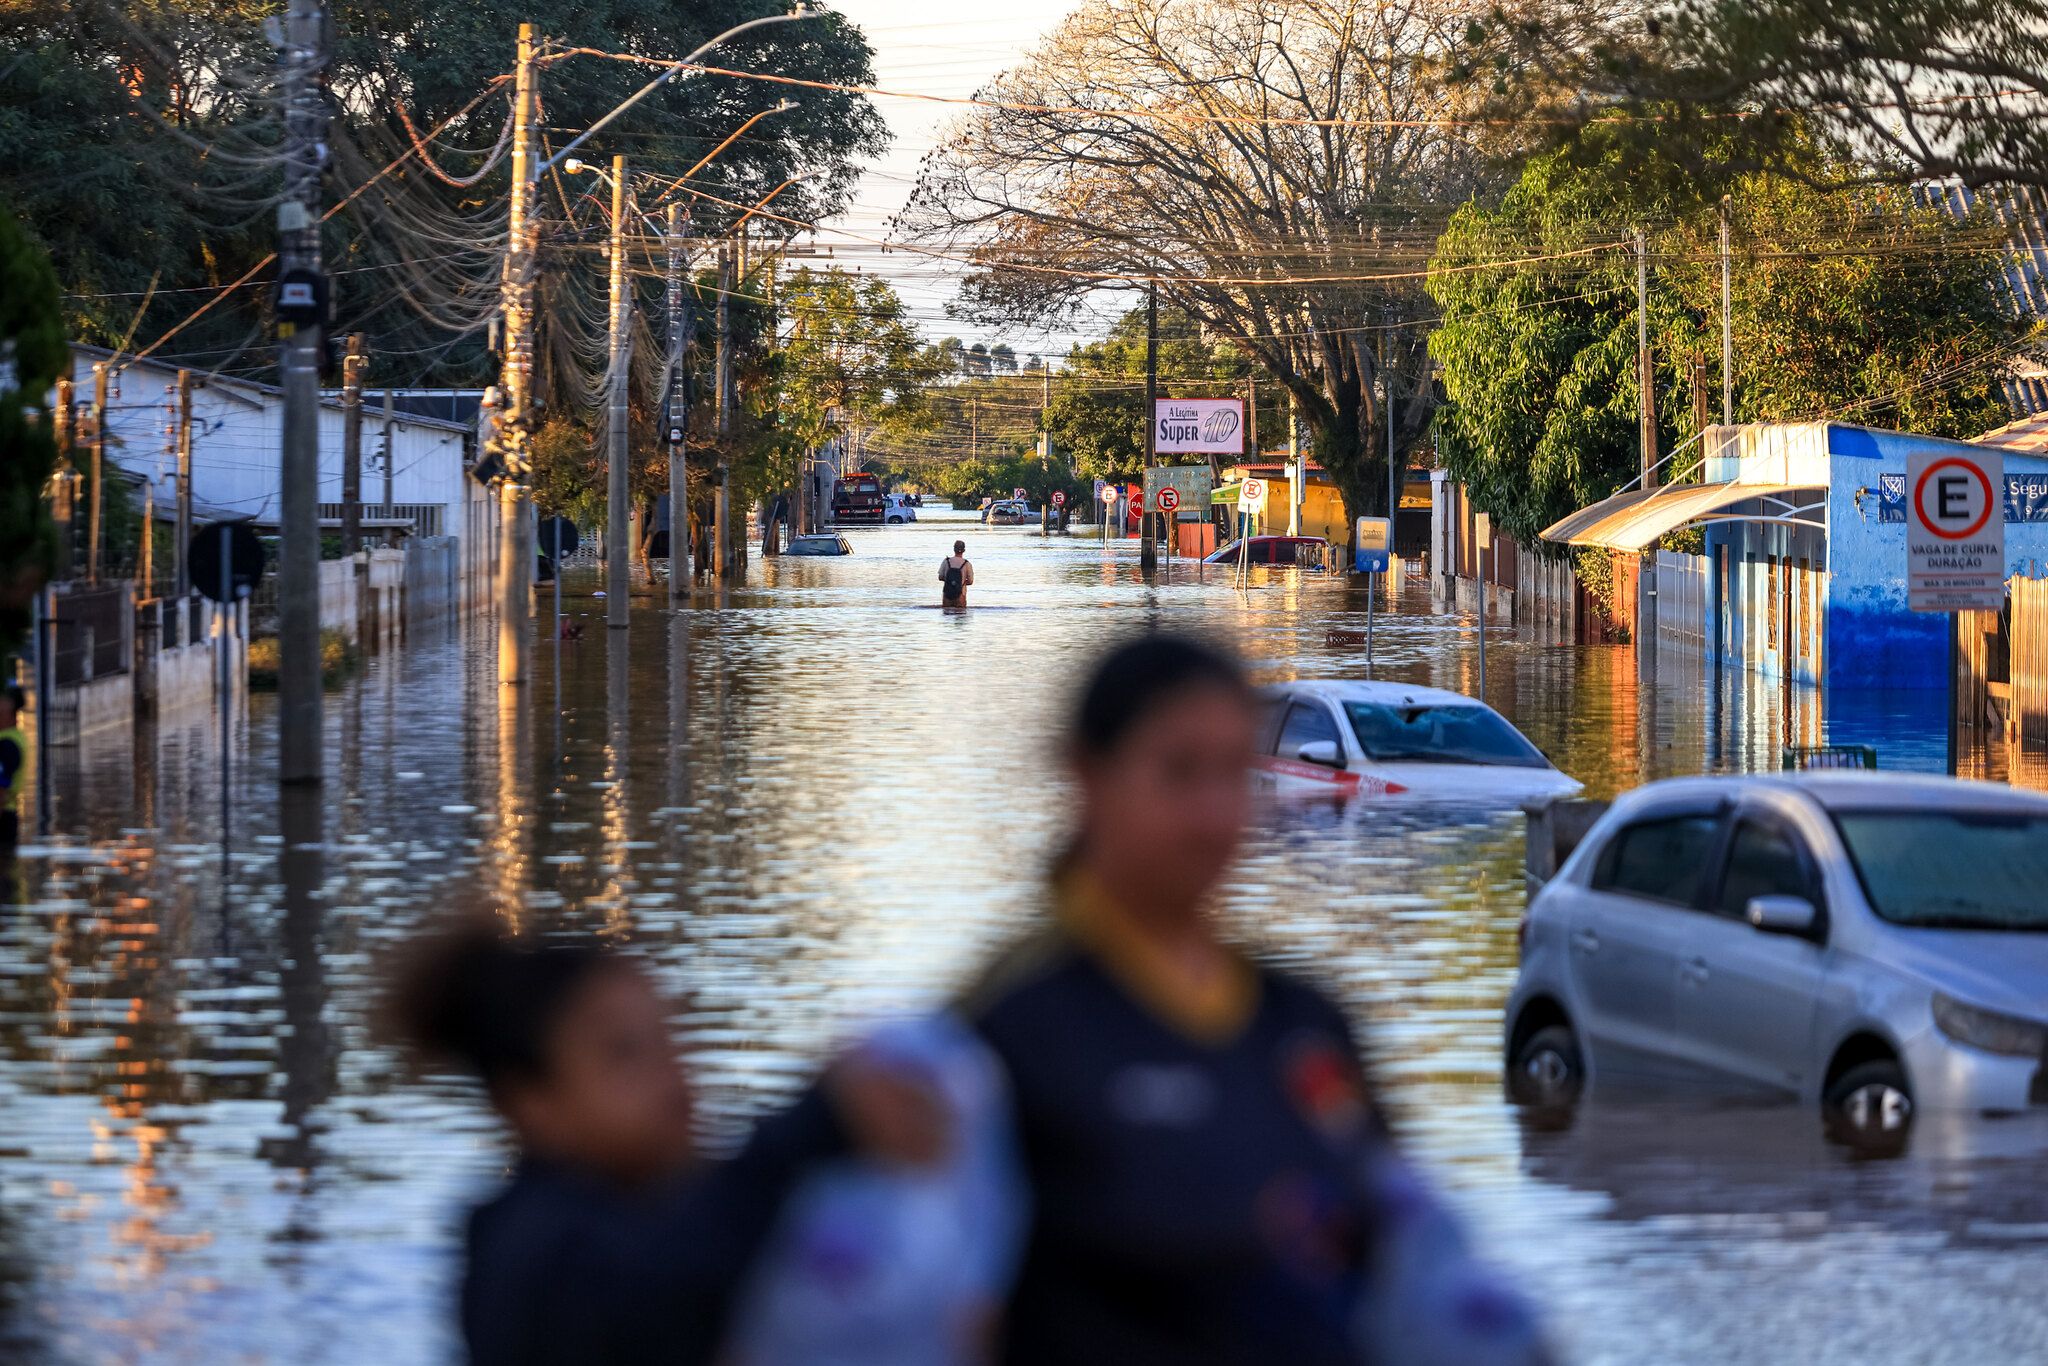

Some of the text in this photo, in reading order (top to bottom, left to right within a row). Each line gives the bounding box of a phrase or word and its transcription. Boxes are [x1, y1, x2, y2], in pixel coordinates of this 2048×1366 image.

[1169, 407, 1174, 417] A
[1204, 408, 1239, 443] 10
[2010, 481, 2048, 499] Segu
[1938, 476, 1970, 519] E
[1131, 501, 1142, 509] PA
[1912, 543, 1998, 555] VAGA DE CURTA
[1928, 556, 1982, 570] DURAÇÃO
